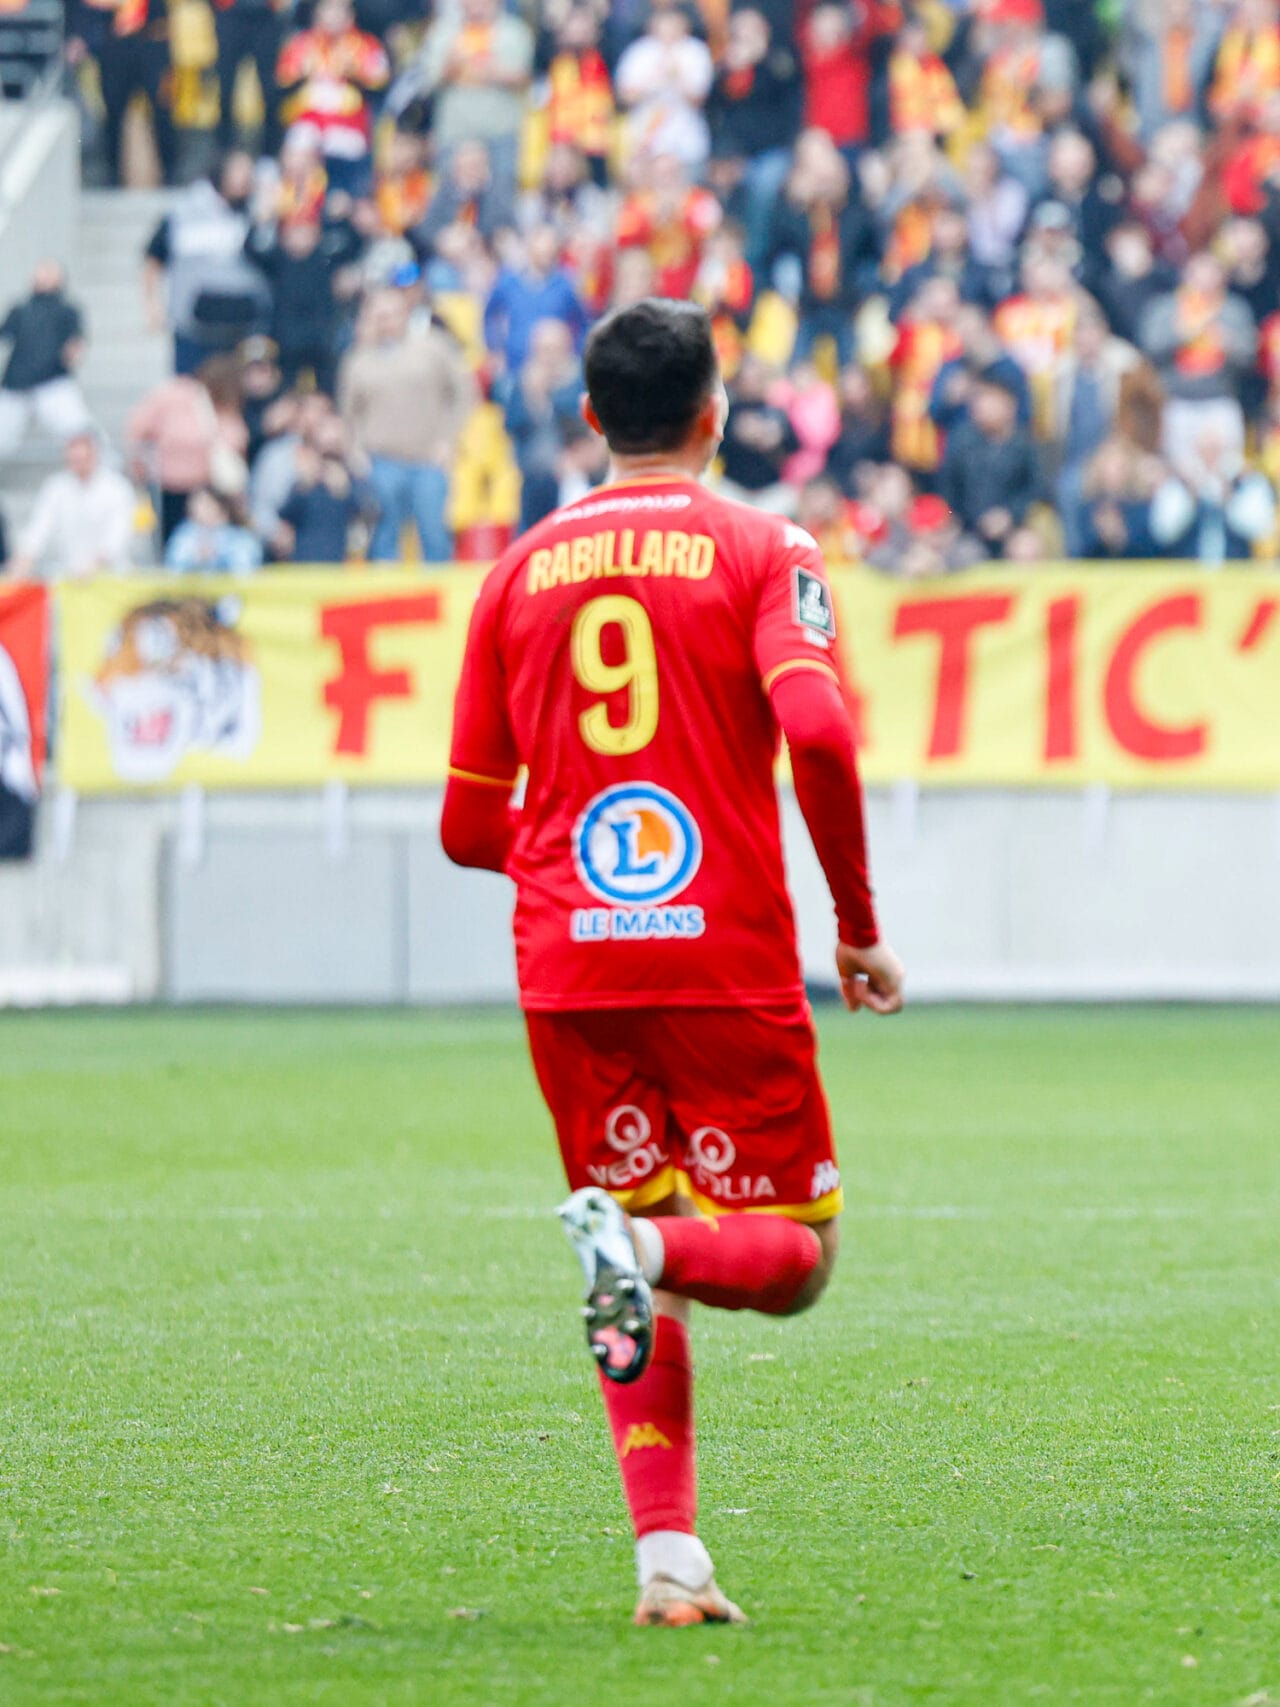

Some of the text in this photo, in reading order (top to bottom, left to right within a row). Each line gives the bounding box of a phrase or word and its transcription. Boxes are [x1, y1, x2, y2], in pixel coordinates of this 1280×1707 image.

[529, 529, 715, 593] RABILLARD
[571, 593, 660, 756] 9
[575, 906, 703, 938] LE MANS
